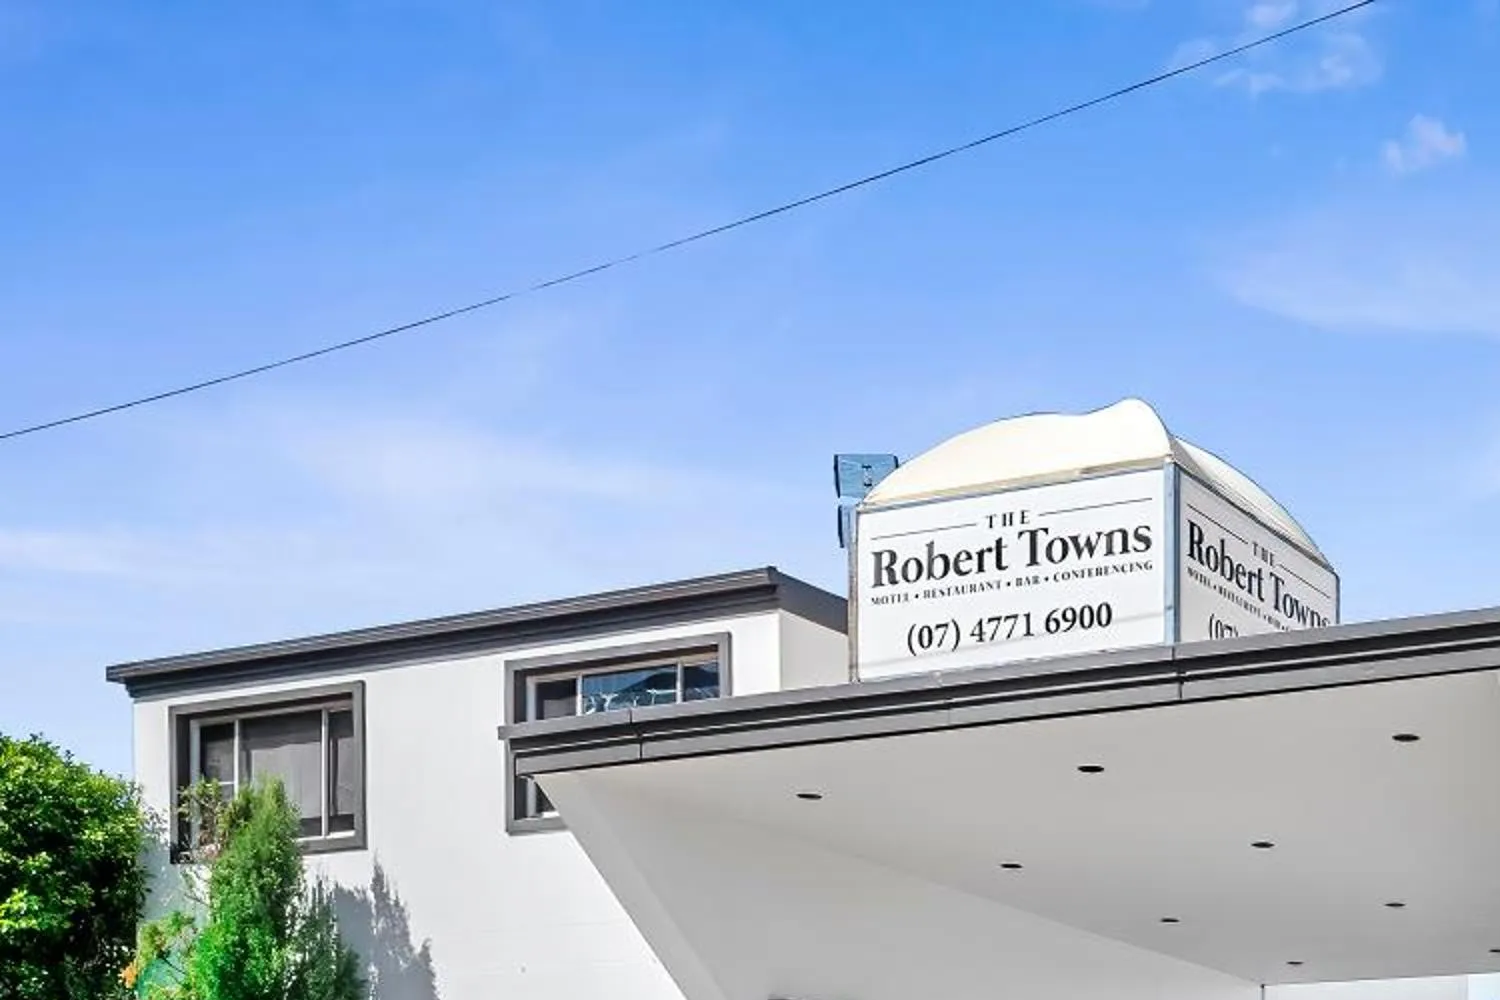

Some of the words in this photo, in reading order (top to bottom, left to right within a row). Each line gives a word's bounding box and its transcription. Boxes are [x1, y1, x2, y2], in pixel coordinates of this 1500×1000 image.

[985, 510, 1030, 529] THE
[871, 540, 1008, 588] Robert
[1018, 525, 1153, 567] Towns
[1187, 519, 1265, 602] Robert
[1252, 541, 1275, 567] THE
[923, 580, 1002, 599] RESTAURANT
[1015, 575, 1041, 588] BAR
[1053, 560, 1154, 582] CONFERENCING
[907, 618, 961, 656] (07)
[970, 612, 1035, 643] 4771
[1045, 602, 1113, 634] 6900
